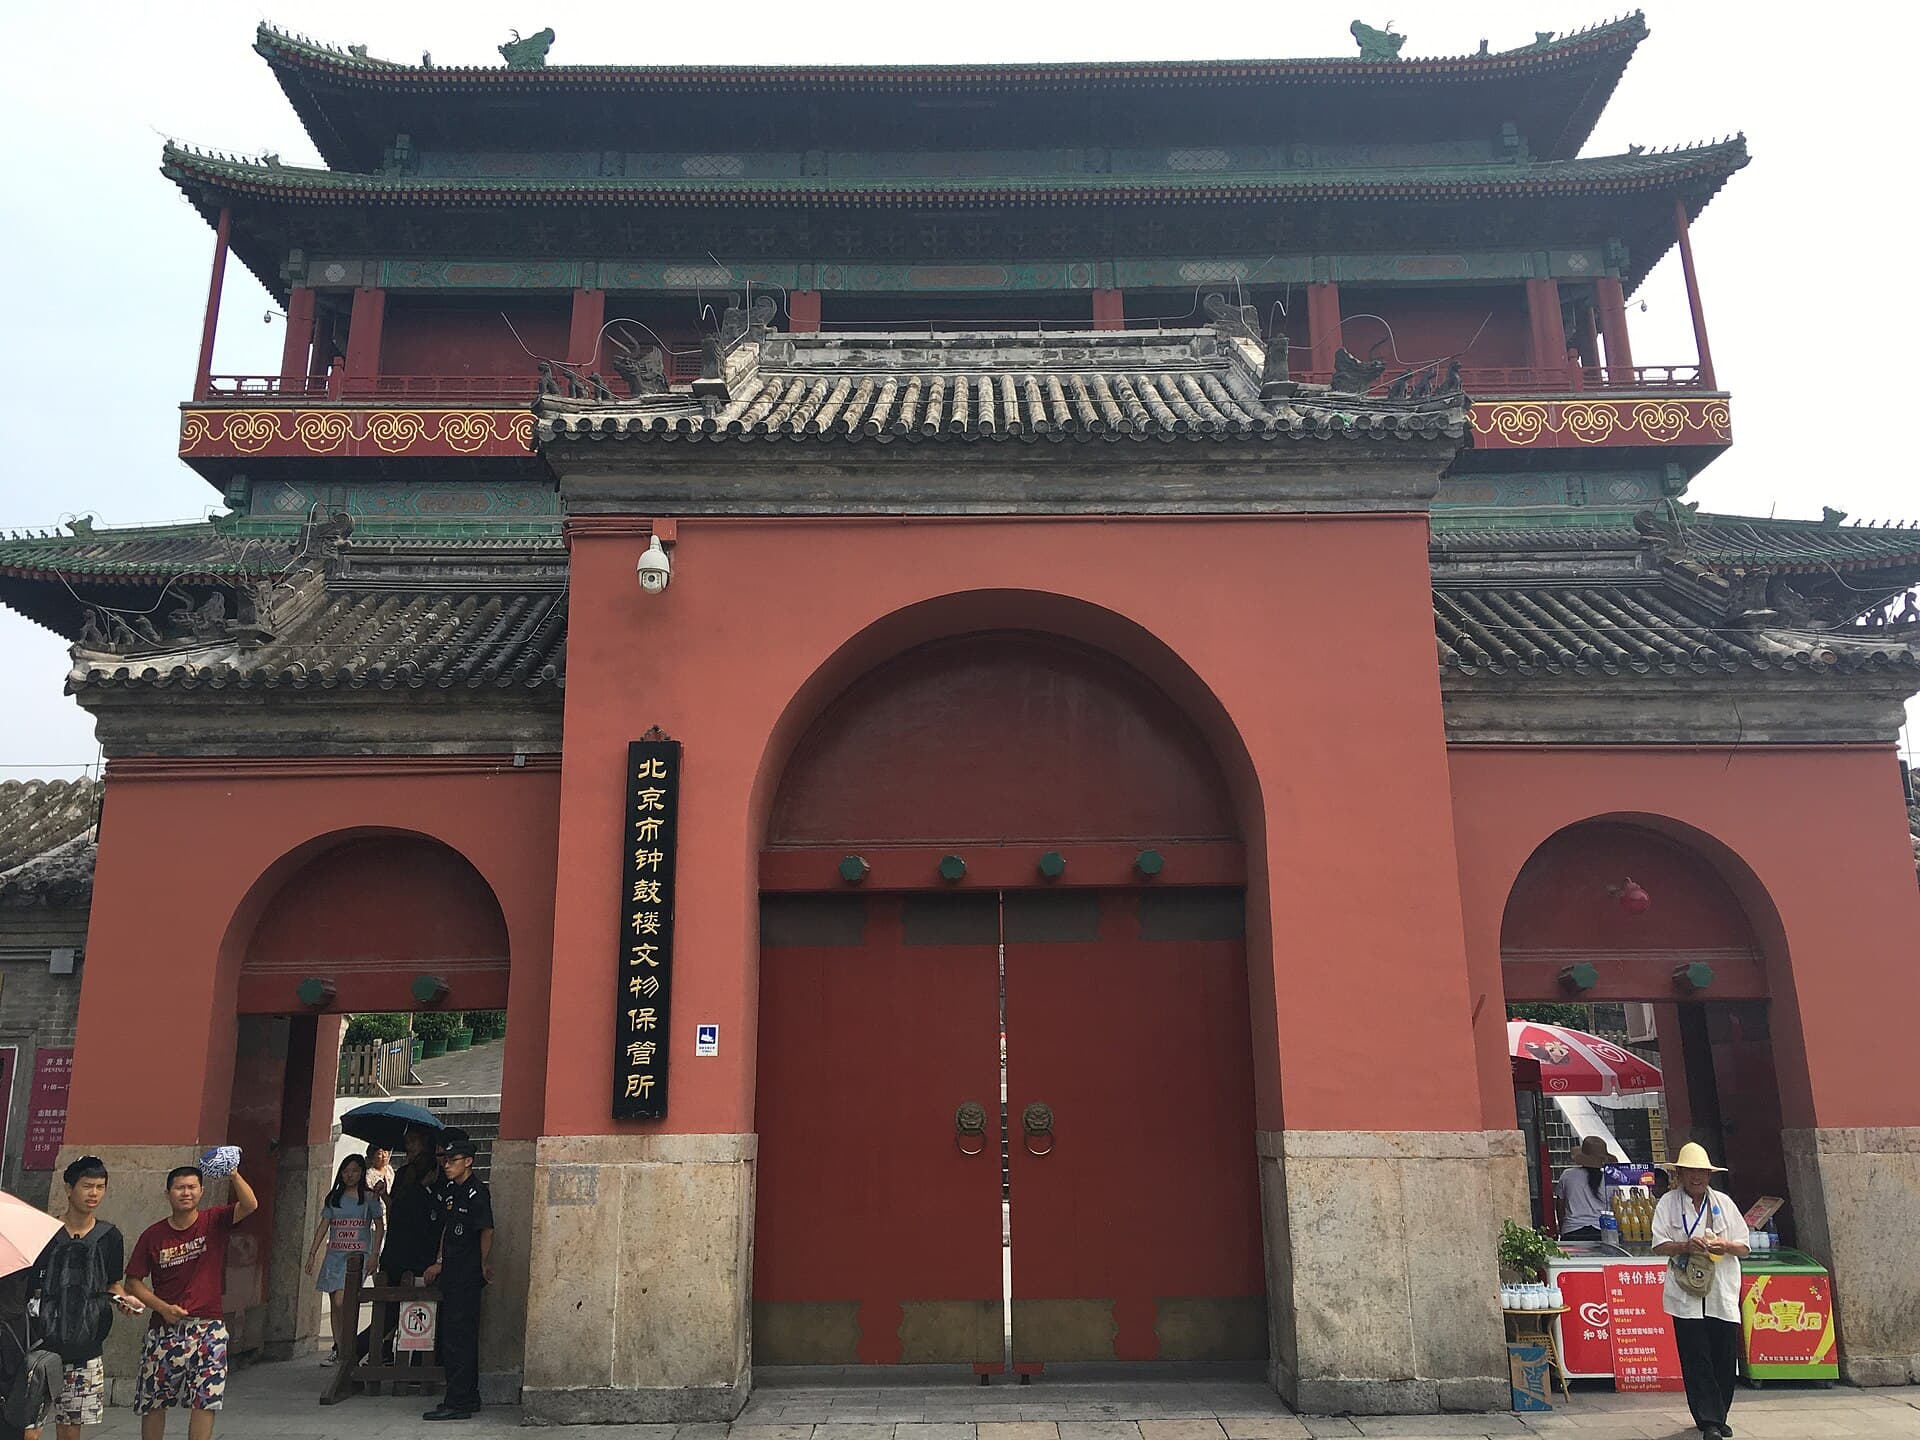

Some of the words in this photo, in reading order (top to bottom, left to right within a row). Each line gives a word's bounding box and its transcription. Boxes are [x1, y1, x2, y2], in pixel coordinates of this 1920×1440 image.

[624, 757, 668, 1101] 北京市钟鼓楼文物保管所
